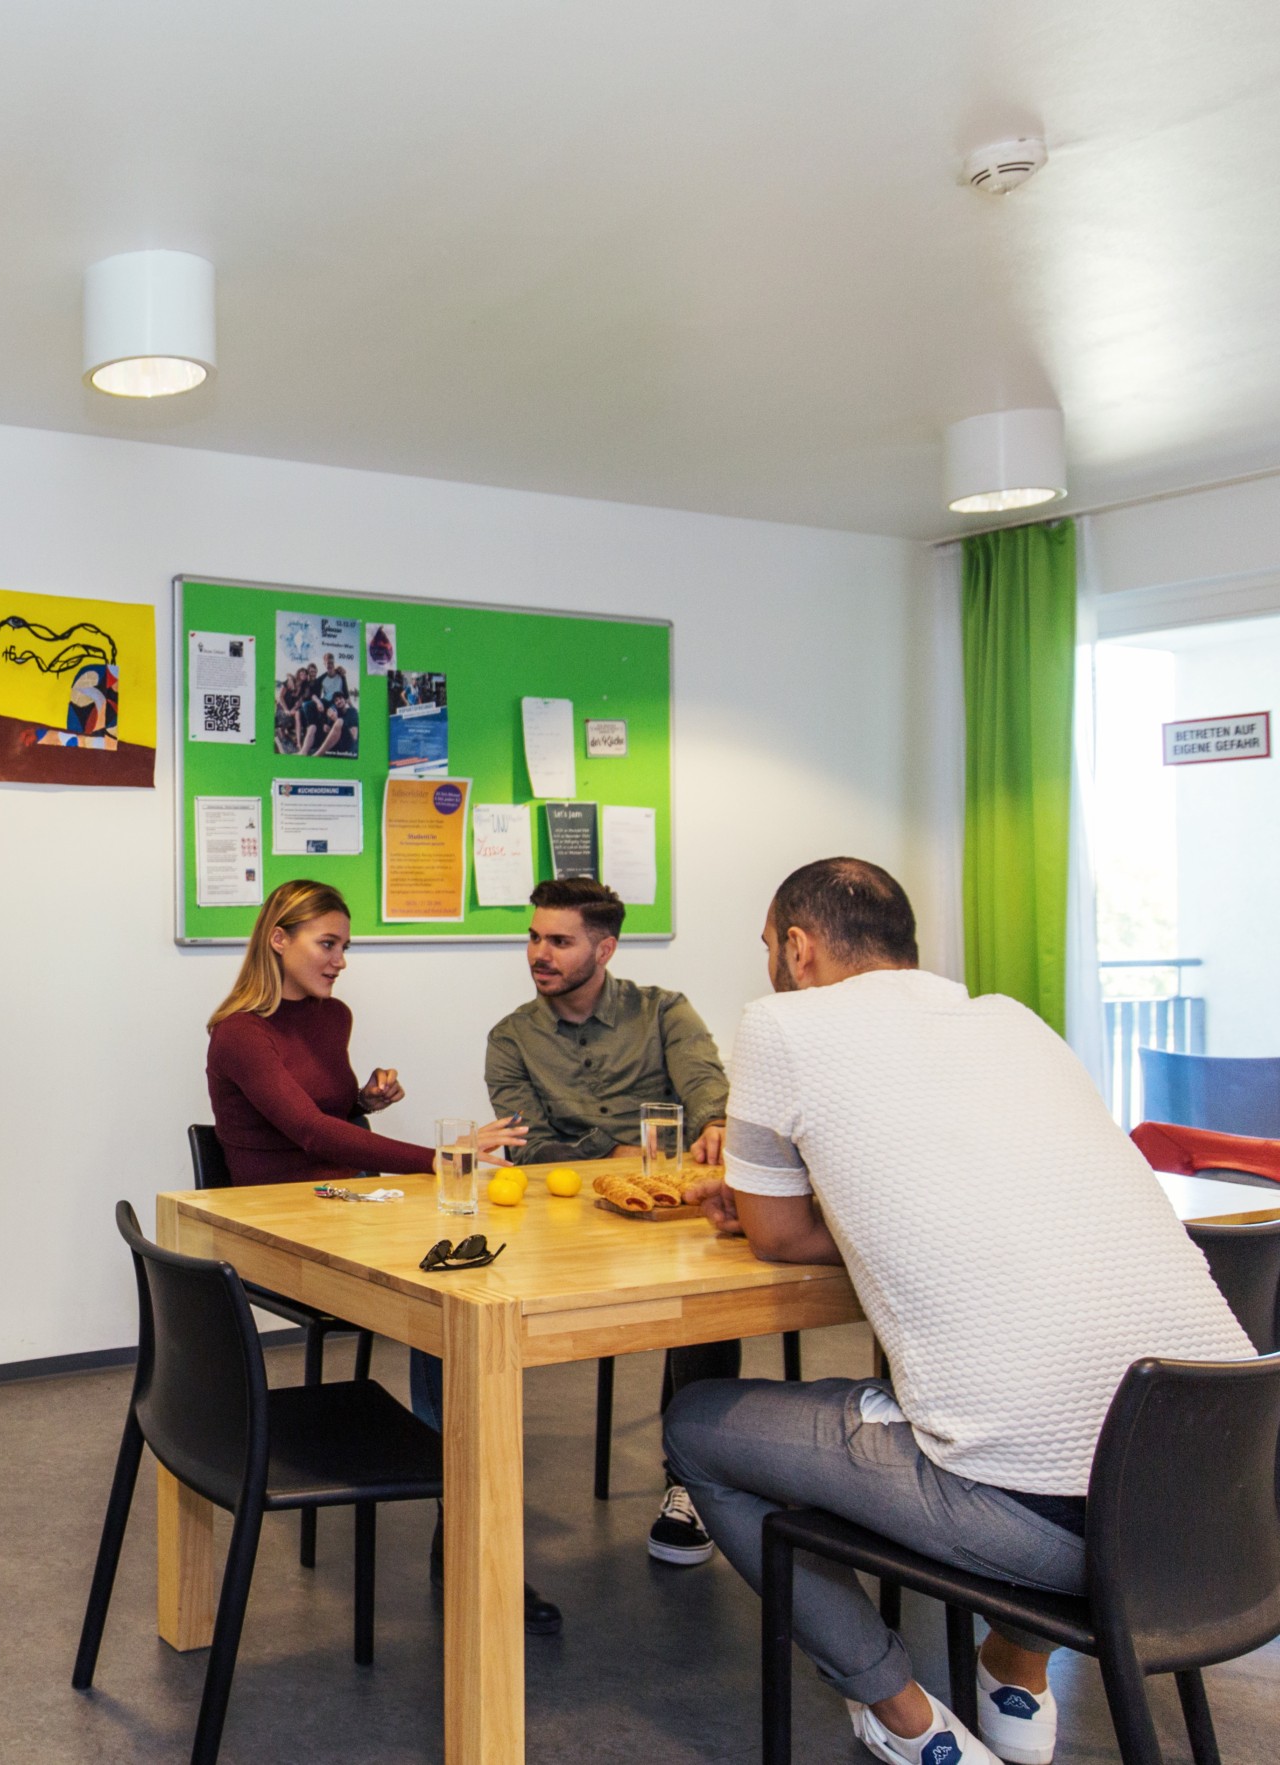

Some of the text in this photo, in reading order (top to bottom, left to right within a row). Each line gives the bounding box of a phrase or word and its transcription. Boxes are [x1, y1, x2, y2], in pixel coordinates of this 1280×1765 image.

[1175, 723, 1257, 742] BETRETEN AUF
[1173, 737, 1260, 756] EIGENE GEFAHR
